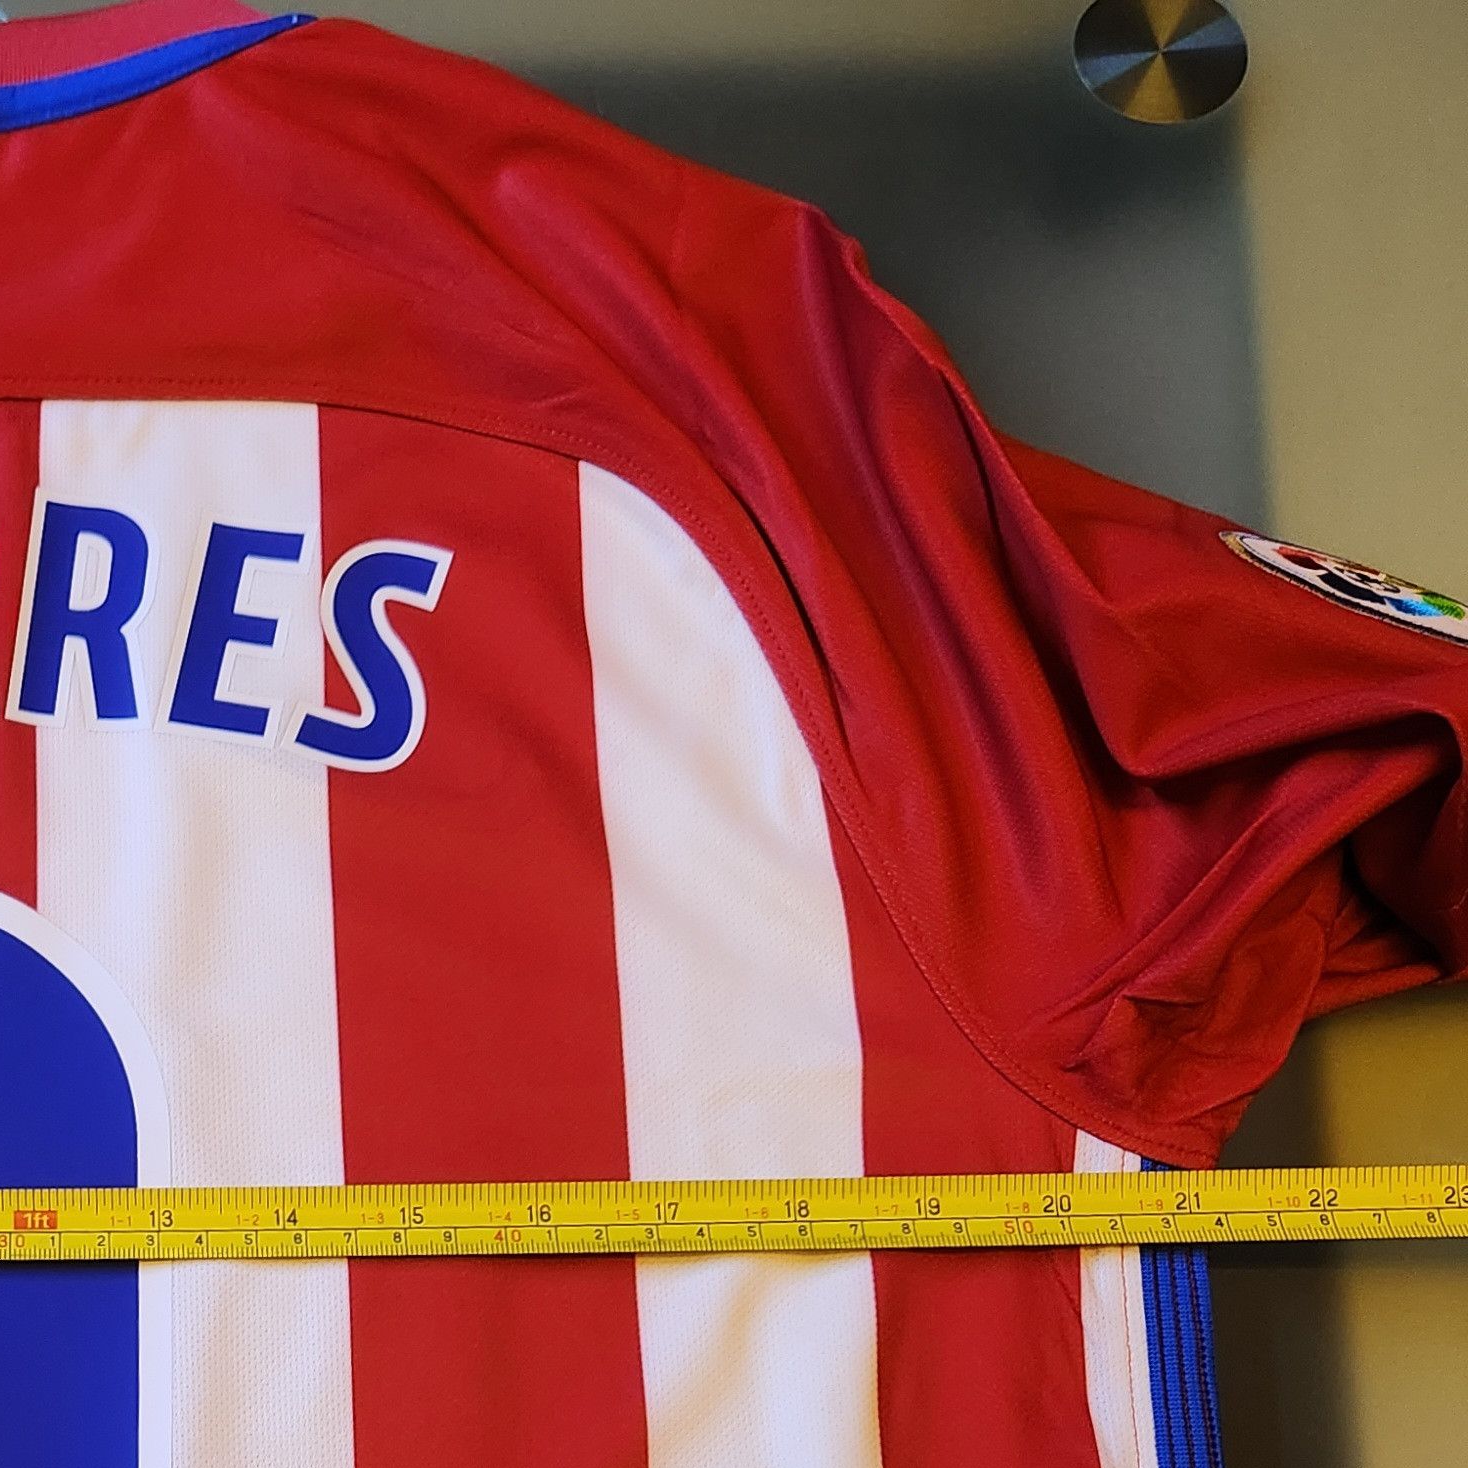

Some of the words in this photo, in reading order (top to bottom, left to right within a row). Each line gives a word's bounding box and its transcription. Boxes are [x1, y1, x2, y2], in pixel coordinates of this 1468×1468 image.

[22, 1212, 50, 1229] 1ft
[110, 1215, 132, 1227] 1-1
[149, 1209, 174, 1228] 13
[236, 1214, 260, 1226] 1-2
[274, 1208, 299, 1226] 14
[361, 1212, 385, 1225] 1-3
[399, 1206, 424, 1225] 15
[488, 1211, 512, 1223] 1-4
[527, 1204, 552, 1223] 16
[654, 1201, 680, 1221] 17
[784, 1199, 810, 1219] 18
[874, 1204, 899, 1216] 1-7
[915, 1197, 941, 1216] 19
[1042, 1194, 1072, 1214] 20
[1175, 1191, 1201, 1210] 21
[1308, 1188, 1339, 1207] 22
[49, 1235, 55, 1247] 1
[96, 1235, 106, 1247] 2
[145, 1235, 155, 1246] 3
[194, 1234, 204, 1246] 4
[243, 1234, 253, 1245] 5
[293, 1233, 303, 1244] 6
[343, 1232, 353, 1244] 7
[393, 1231, 402, 1243] 8
[443, 1231, 452, 1242] 9
[546, 1229, 552, 1241] 1
[594, 1228, 604, 1240] 2
[644, 1227, 654, 1239] 3
[695, 1226, 705, 1238] 4
[746, 1225, 757, 1237] 5
[798, 1225, 808, 1236] 6
[849, 1224, 859, 1236] 7
[901, 1223, 912, 1234] 8
[952, 1222, 963, 1233] 9
[1059, 1219, 1066, 1232] 1
[1108, 1218, 1119, 1231] 2
[1161, 1217, 1172, 1229] 3
[1214, 1216, 1224, 1228] 4
[1267, 1215, 1278, 1227] 5
[1372, 1213, 1382, 1224] 7
[1426, 1211, 1437, 1223] 8
